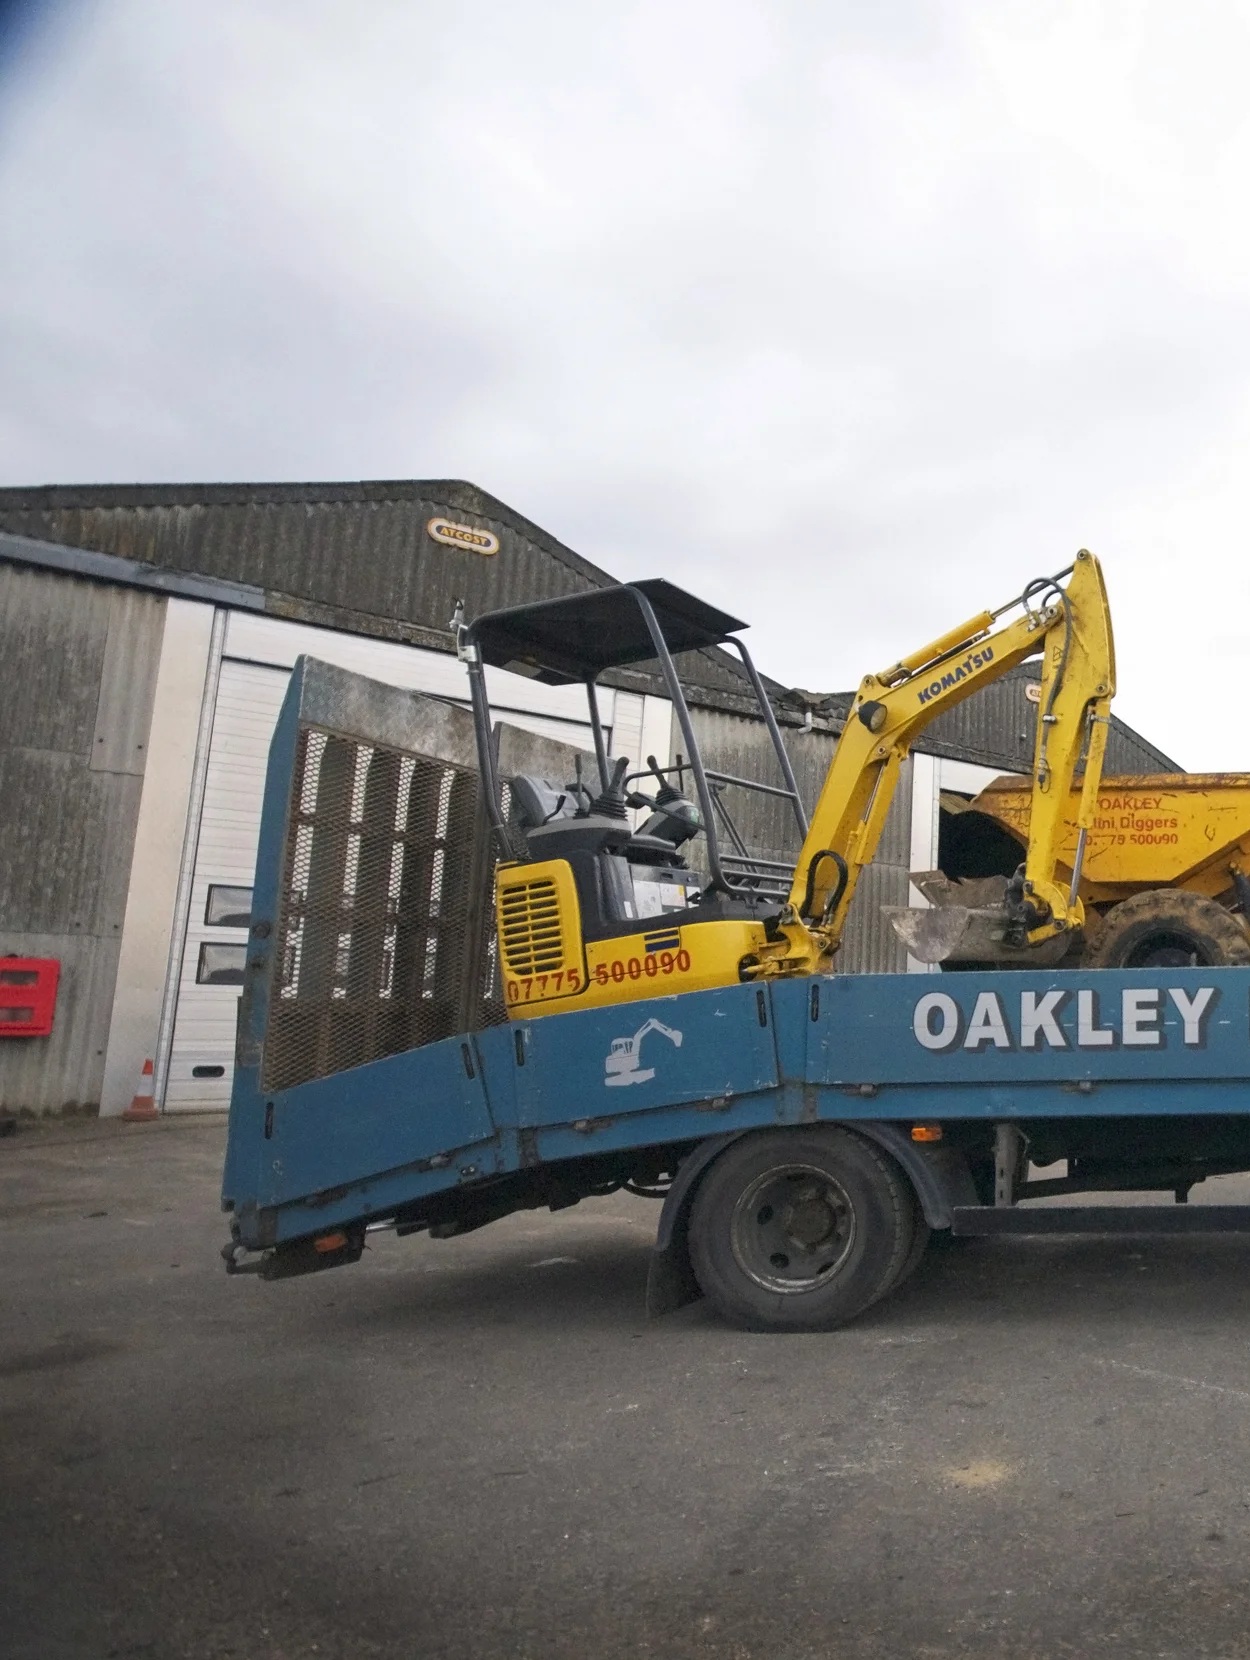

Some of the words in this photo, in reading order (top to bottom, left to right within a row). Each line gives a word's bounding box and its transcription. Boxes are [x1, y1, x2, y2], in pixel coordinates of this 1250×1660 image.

[440, 527, 487, 545] ATCOST
[917, 646, 994, 704] KOMATSU
[1100, 798, 1162, 810] OAKLEY
[1120, 816, 1178, 832] Diggers
[507, 968, 581, 1002] 07775
[595, 949, 691, 986] 500090
[912, 987, 1215, 1051] OAKLEY
